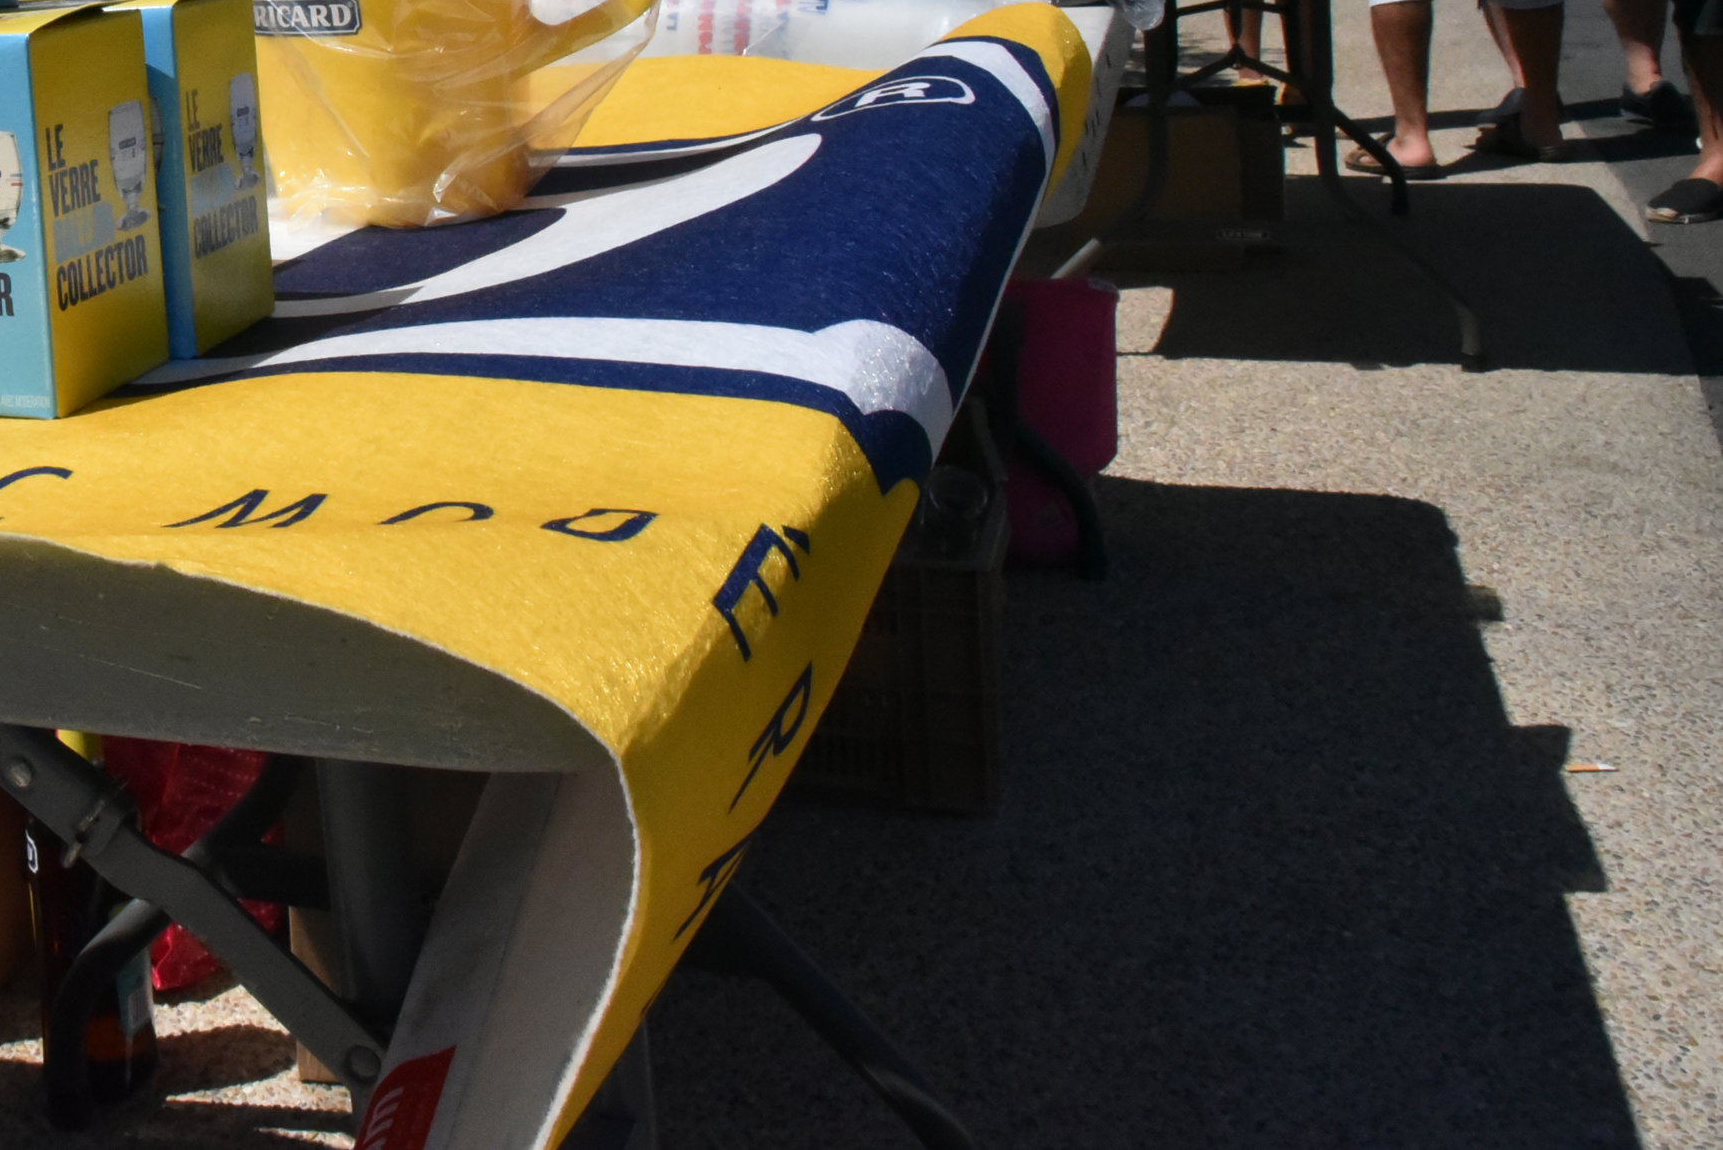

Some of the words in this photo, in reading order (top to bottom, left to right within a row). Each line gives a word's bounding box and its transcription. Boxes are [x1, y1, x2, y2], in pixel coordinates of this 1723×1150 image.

[253, 3, 352, 28] RICARD
[46, 123, 65, 171] LE
[48, 159, 101, 217] VERRE
[57, 234, 148, 312] COLLECTOR
